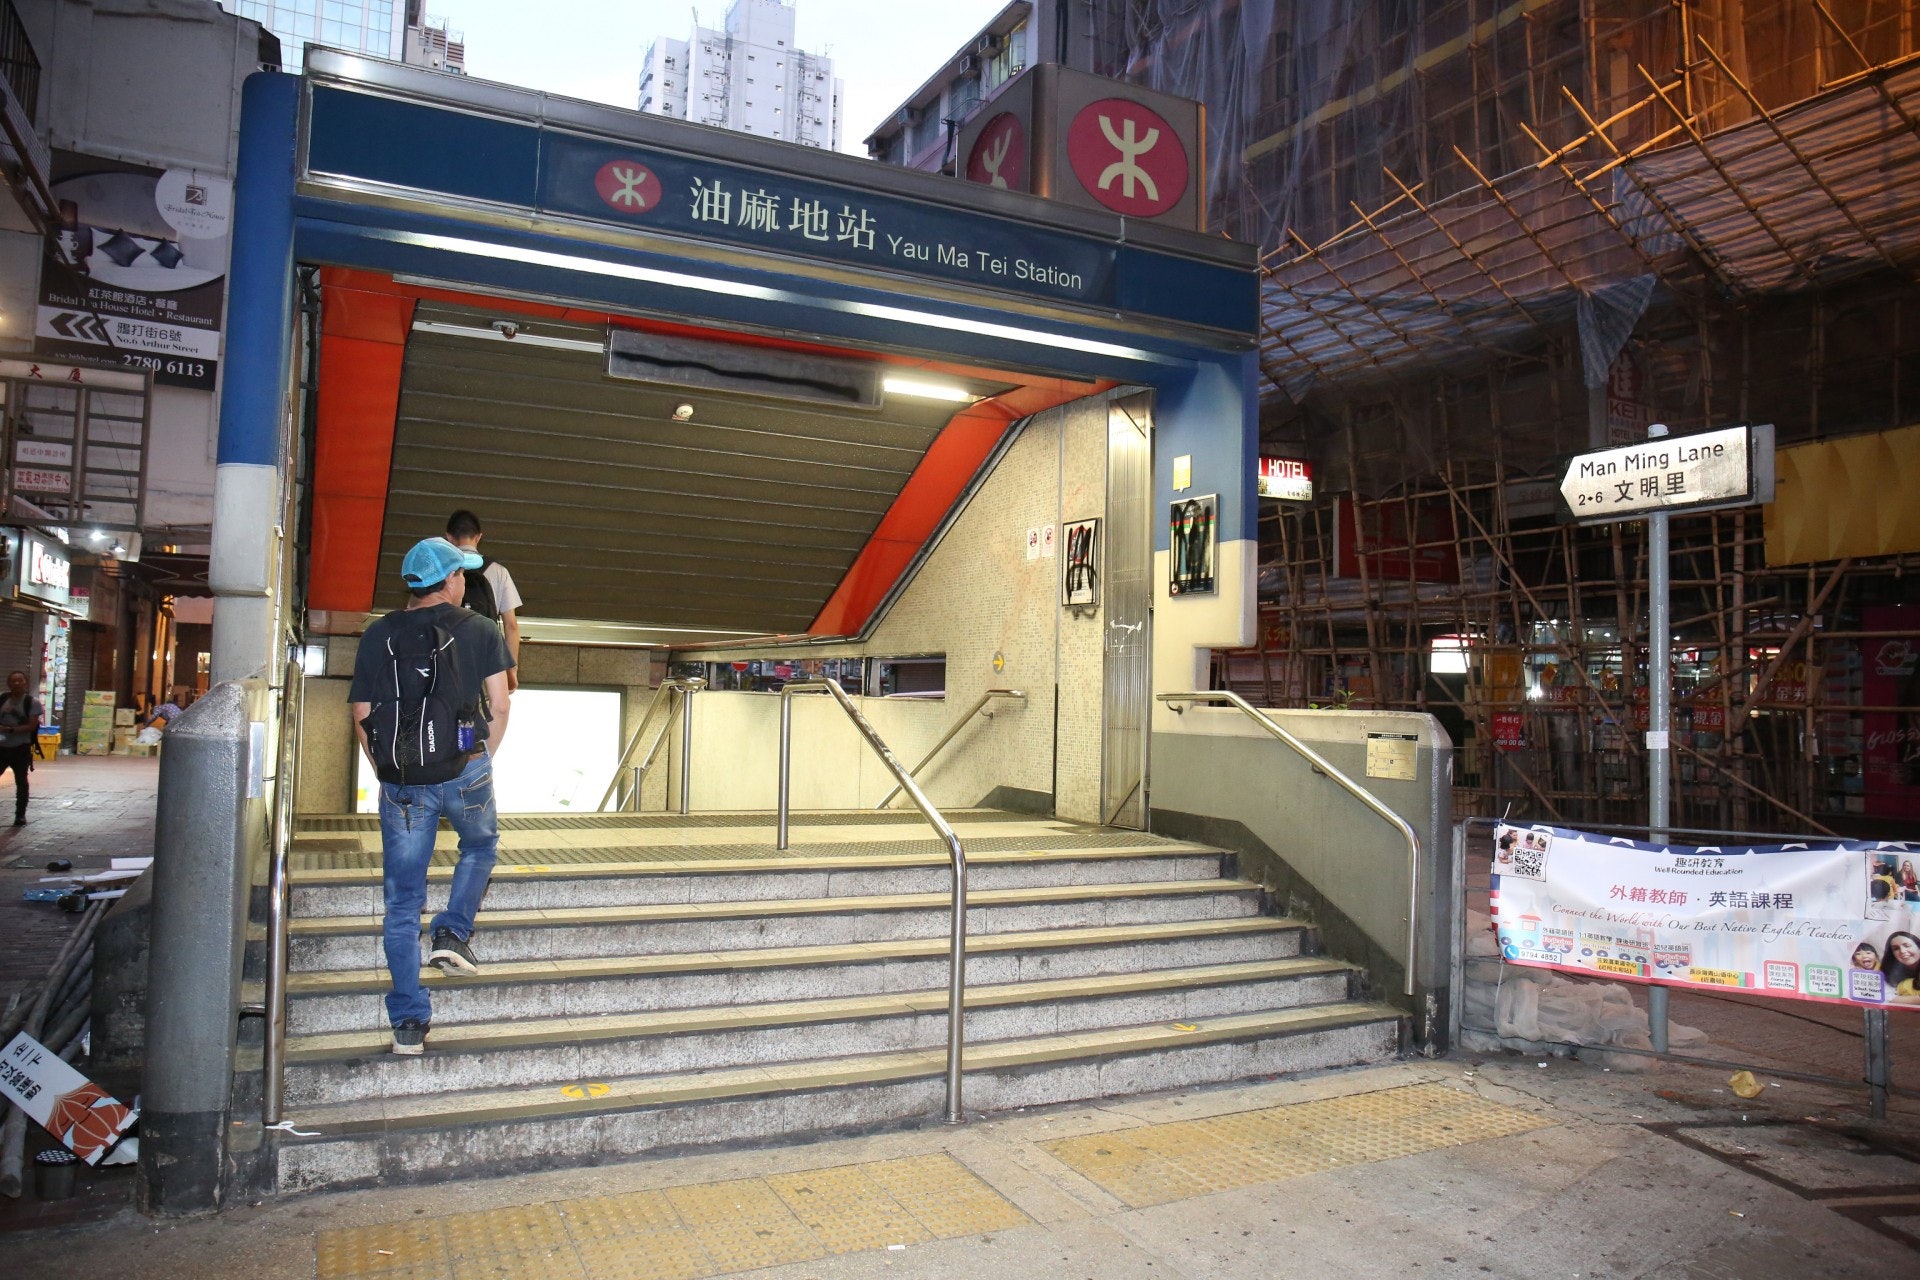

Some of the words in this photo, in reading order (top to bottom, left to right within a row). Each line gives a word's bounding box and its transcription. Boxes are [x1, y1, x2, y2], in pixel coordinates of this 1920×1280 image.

[690, 176, 877, 251] 油麻地站
[887, 234, 929, 262] Yau
[937, 244, 969, 268] Ma
[977, 251, 1007, 276] Tei
[1015, 259, 1082, 290] Station
[49, 293, 78, 305] Bridal
[100, 302, 129, 314] House
[131, 306, 155, 318] Hotel
[166, 311, 213, 327] Restaurant
[116, 335, 139, 346] No.6
[140, 338, 171, 351] Arthur
[172, 343, 199, 354] Street
[122, 354, 162, 372] 2780
[166, 361, 205, 378] 6113
[1268, 458, 1309, 480] HOTEL
[1580, 461, 1616, 478] Man
[1625, 452, 1669, 472] Ming
[1678, 443, 1724, 463] Lane
[1614, 471, 1686, 504] 文明里
[428, 719, 436, 753] DIADORA
[1705, 868, 1744, 876] Education
[1609, 884, 1688, 907] 外籍教師
[1708, 890, 1794, 910] 英語課程
[1552, 904, 1587, 917] Connect
[1589, 906, 1606, 920] the
[1606, 911, 1638, 925] World
[1641, 914, 1664, 928] with
[1667, 919, 1690, 930] Our
[1693, 921, 1717, 932] Best
[1721, 921, 1757, 934] Native
[1760, 921, 1803, 944] English
[1807, 926, 1853, 941] Teachers
[1520, 950, 1538, 959] 9794
[1540, 953, 1558, 962] 4852
